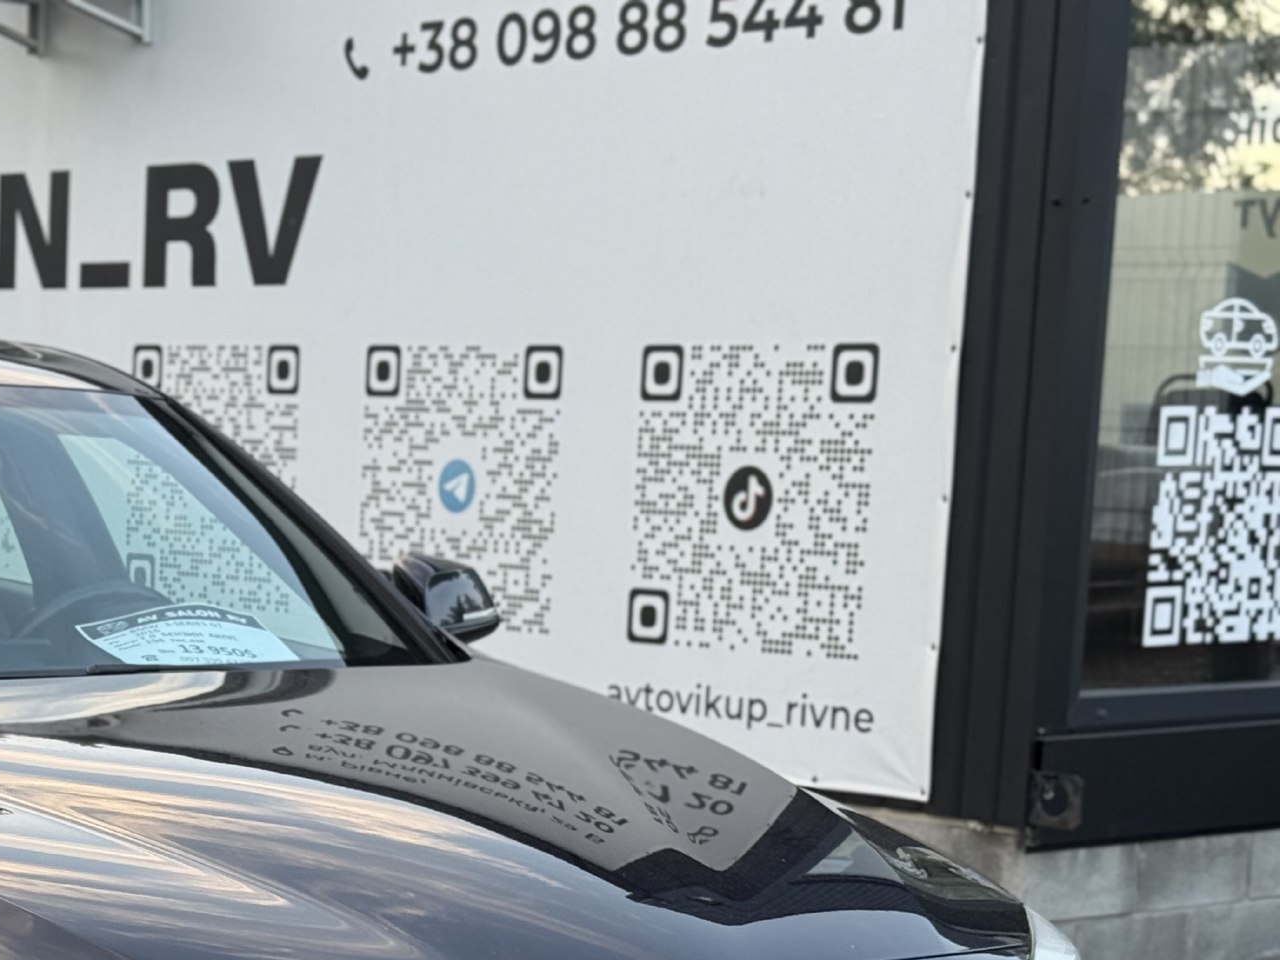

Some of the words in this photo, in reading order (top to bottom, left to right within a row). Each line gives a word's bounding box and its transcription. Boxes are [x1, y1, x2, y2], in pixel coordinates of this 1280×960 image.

[392, 17, 479, 73] +38
[496, 5, 597, 66] 098
[616, 0, 687, 56] 88
[705, 0, 825, 47] 544
[607, 683, 875, 734] avtovikup_rivne
